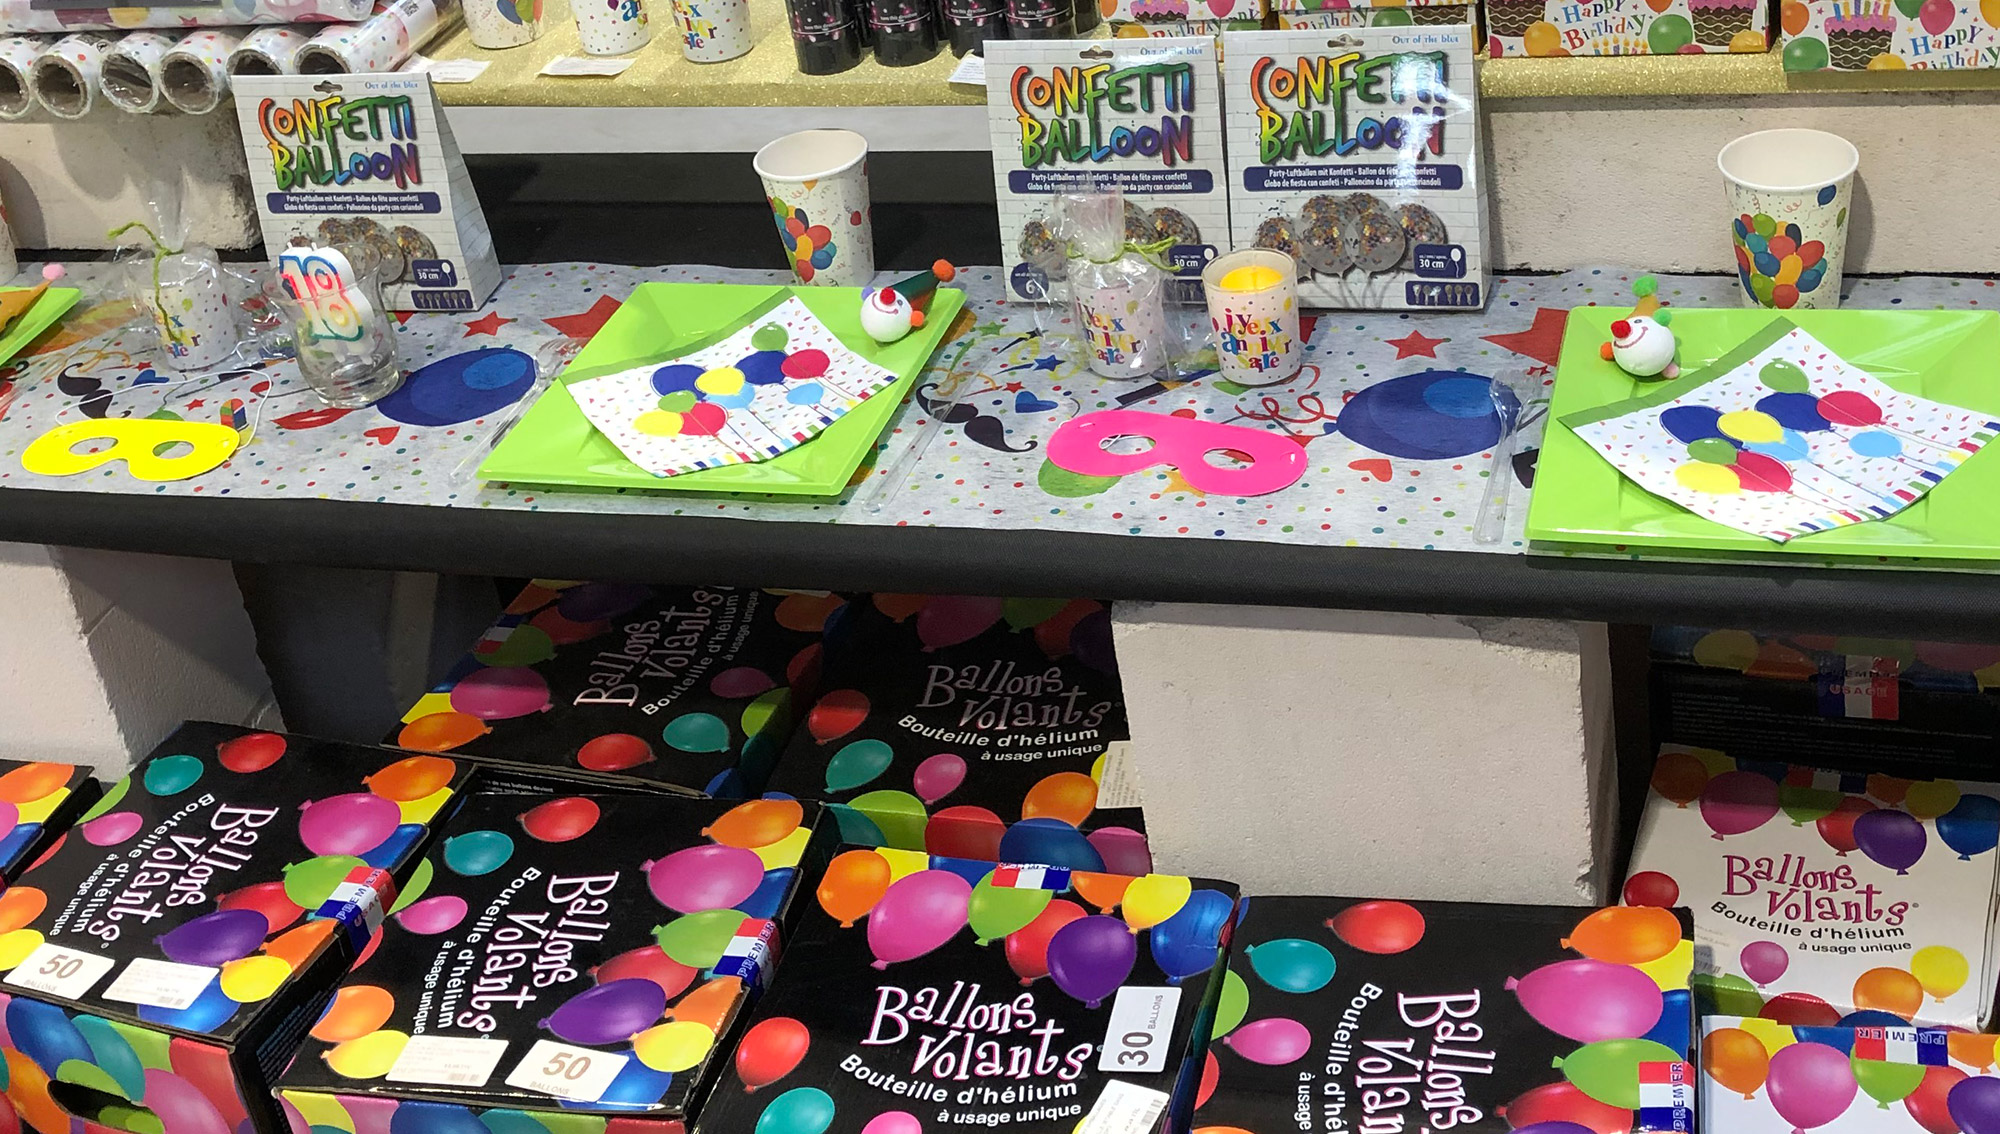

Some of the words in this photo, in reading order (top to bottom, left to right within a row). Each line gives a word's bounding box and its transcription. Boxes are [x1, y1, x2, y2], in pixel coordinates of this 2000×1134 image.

[1010, 63, 1191, 117] CONFETTI
[1017, 115, 1192, 167] BALLOON
[269, 142, 421, 190] BALLOON
[1165, 172, 1187, 180] confetti
[1329, 168, 1353, 176] Konfetti
[1358, 168, 1377, 176] Ballon
[1344, 178, 1375, 187] Palloncino
[1026, 280, 1035, 294] 6
[1420, 259, 1430, 268] 30
[639, 590, 723, 678] Volants
[641, 657, 713, 716] Bouteille
[707, 595, 739, 653] d'hélium
[573, 620, 660, 707] Ballons
[916, 660, 1064, 708] Ballons
[898, 714, 990, 747] Bouteille
[997, 729, 1099, 747] d'hélium
[959, 685, 1112, 731] Volants
[995, 751, 1042, 763] usage
[1047, 743, 1102, 759] unique
[128, 793, 215, 859] Bouteille
[78, 861, 109, 896] usage
[165, 802, 280, 907] Ballons
[1722, 853, 1858, 896] Ballons
[70, 863, 129, 933] d'hélium
[87, 833, 206, 943] Volants
[467, 866, 542, 944] Bouteille
[1767, 883, 1909, 926] Volants
[50, 897, 81, 937] unique
[533, 870, 620, 989] Ballons
[1711, 901, 1802, 937] Bouteille
[1810, 926, 1905, 940] d'hélium
[39, 954, 84, 979] 50
[425, 950, 449, 990] usage
[737, 920, 777, 978] PREMIER
[1812, 944, 1856, 955] usage
[1860, 941, 1912, 954] unique
[437, 948, 476, 1029] d'hélium
[456, 911, 551, 1034] Volants
[413, 991, 434, 1034] unique
[861, 980, 1037, 1046] Ballons
[1117, 1031, 1153, 1067] 30
[1147, 994, 1164, 1031] BALLONS
[1325, 982, 1384, 1076] Bouteille
[1858, 1027, 1946, 1046] PREMIER
[542, 1051, 592, 1081] 50
[911, 1018, 1093, 1081] Volants
[1397, 988, 1497, 1131] Ballons
[530, 1080, 570, 1096] BALLONS
[839, 1053, 949, 1103] Bouteille
[957, 1081, 1078, 1104] d'hélium
[1355, 1037, 1430, 1134] Volan
[937, 1108, 950, 1123] à
[953, 1111, 1011, 1127] usage
[1016, 1104, 1082, 1123] unique
[1294, 1086, 1312, 1131] usage
